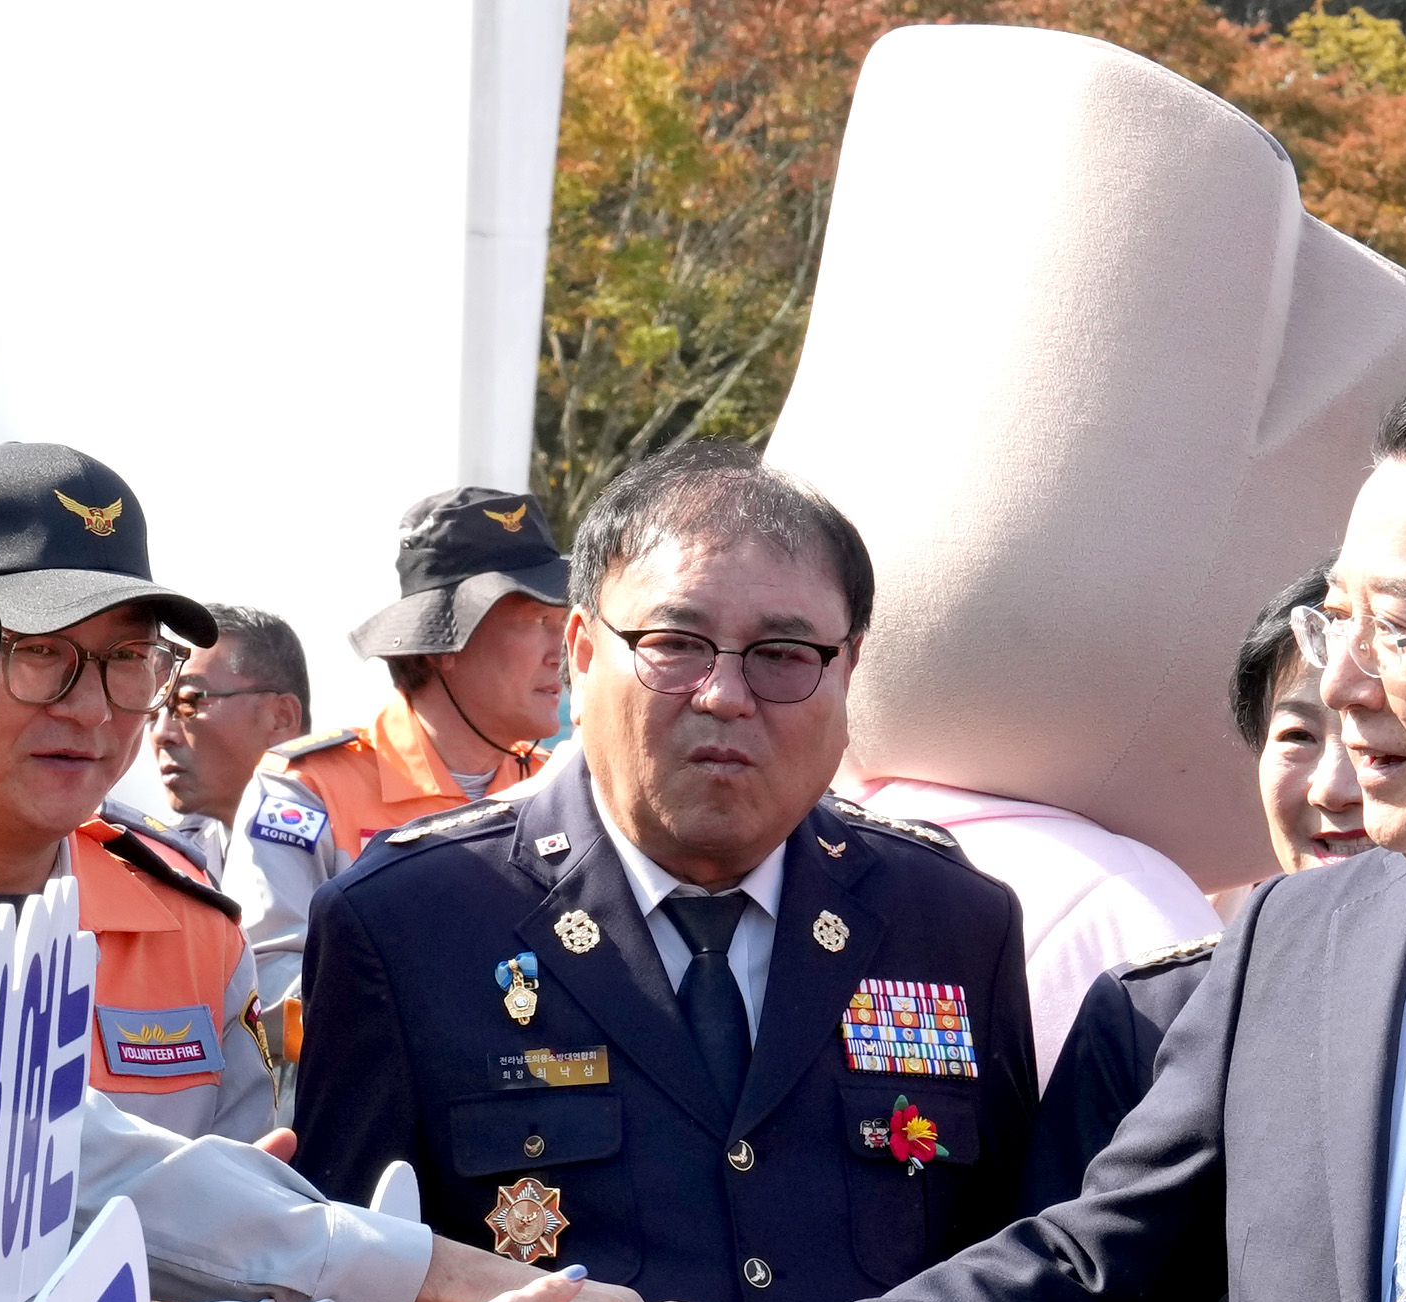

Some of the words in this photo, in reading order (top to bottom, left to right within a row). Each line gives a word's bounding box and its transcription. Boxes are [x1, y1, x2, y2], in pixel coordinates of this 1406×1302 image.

[260, 826, 306, 847] KOREA
[121, 1045, 175, 1061] VOLUNTEER
[175, 1044, 202, 1059] FIRE
